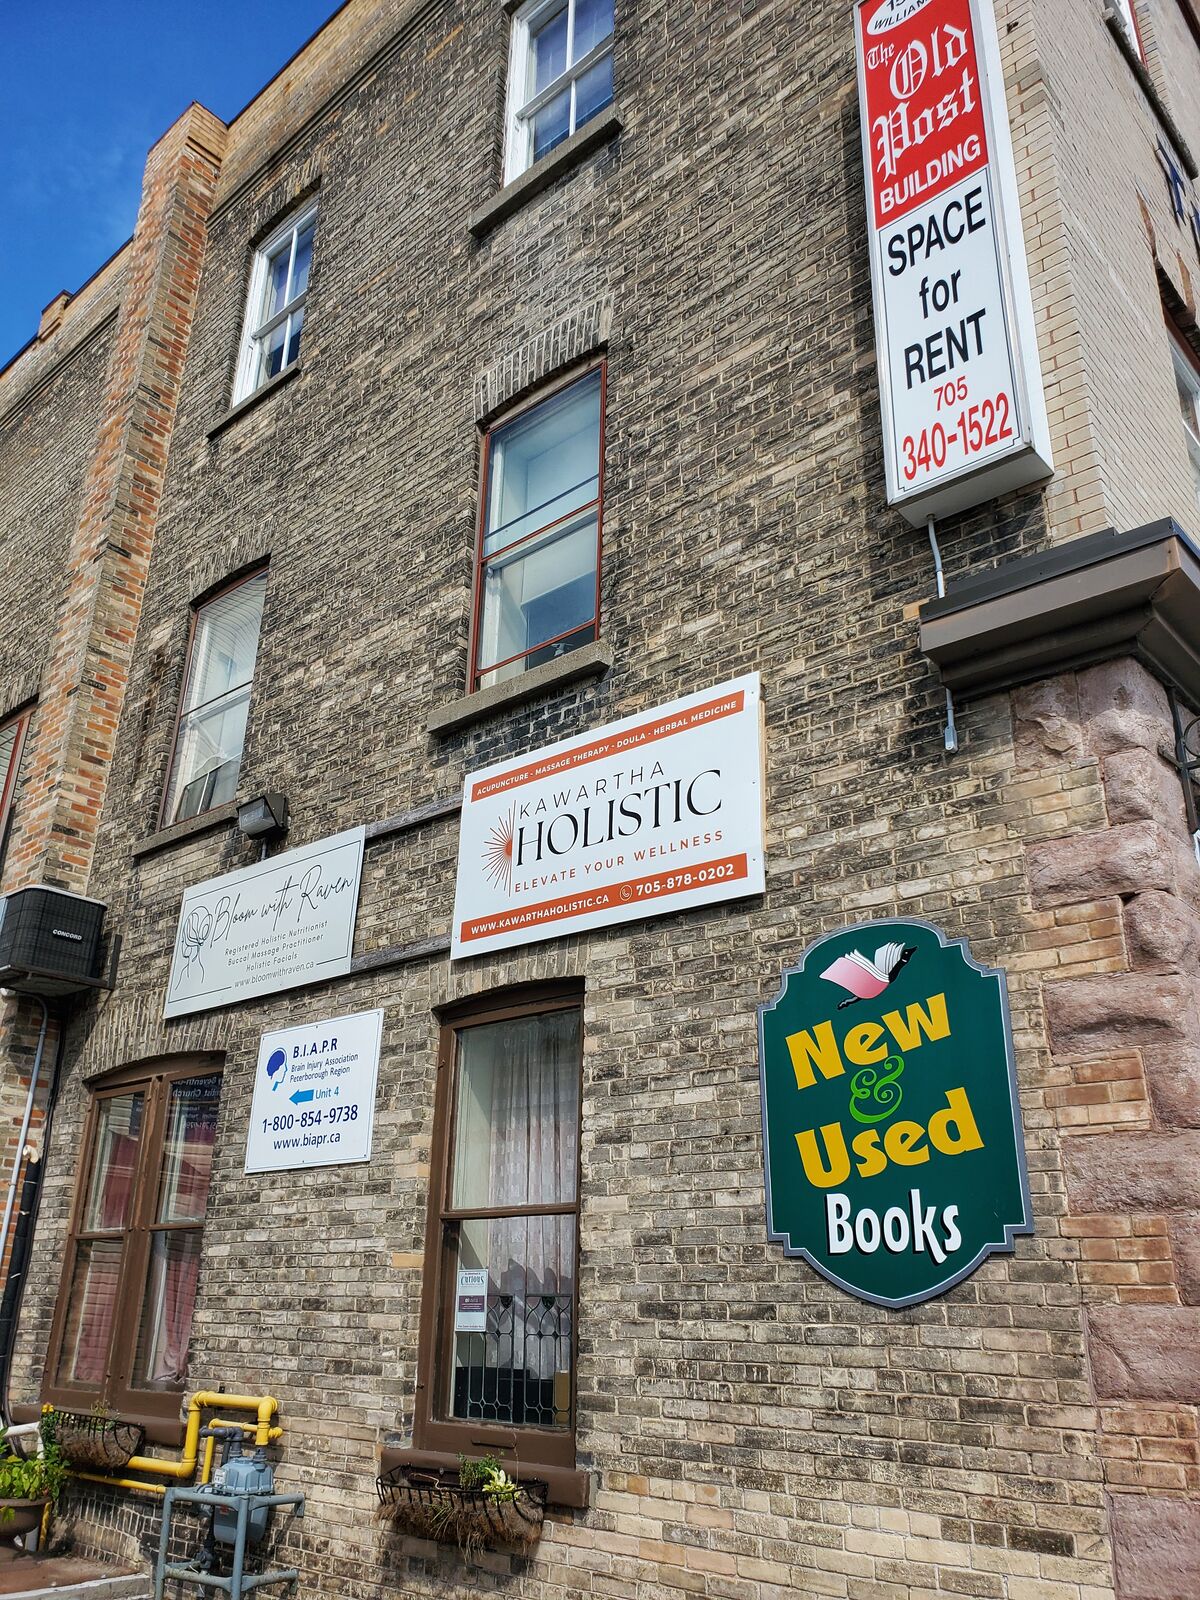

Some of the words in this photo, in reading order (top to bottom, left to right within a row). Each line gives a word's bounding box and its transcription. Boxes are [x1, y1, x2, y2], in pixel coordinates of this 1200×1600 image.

[866, 41, 895, 70] The
[889, 23, 968, 100] Old
[872, 67, 976, 182] Post
[880, 134, 982, 215] BUILDING
[888, 186, 986, 276] SPACE
[919, 269, 961, 319] for
[904, 308, 986, 390] RENT
[933, 376, 968, 411] 705
[902, 392, 1012, 480] 340-1522
[477, 772, 528, 795] ACUPUNCTURE
[535, 758, 570, 776] MASSAGE
[573, 745, 609, 762] THERAPY
[617, 732, 646, 748] DOULA
[653, 719, 688, 735] HERBAL
[690, 701, 737, 722] MEDICINE
[515, 769, 722, 867] HOLISTIC
[519, 761, 665, 820] KAWARTHA
[514, 868, 576, 893] ELEVATE
[584, 855, 625, 874] YOUR
[633, 830, 723, 861] WELLNESS
[210, 893, 259, 948] Bloom
[260, 875, 299, 931] with
[297, 864, 353, 923] Raven
[471, 894, 609, 935] WWW.KAWARTHAHOLISTIC.CA
[636, 863, 735, 896] 705-878-0202
[52, 929, 82, 941] CONCORD
[225, 940, 259, 956] Registered
[261, 932, 286, 946] Holistic
[288, 920, 328, 938] Nutritionist
[228, 953, 250, 966] Buccal
[251, 947, 280, 960] Massage
[282, 934, 324, 951] Practitioner
[246, 960, 271, 972] Holistic
[273, 951, 298, 965] Facials
[234, 961, 314, 988] www.bloomwithraven.ca
[291, 1062, 305, 1073] Brain
[307, 1060, 323, 1072] Injury
[325, 1053, 359, 1066] Association
[292, 1038, 338, 1059] B.I.A.P.R
[785, 992, 951, 1090] New
[289, 1069, 329, 1083] Peterborough
[330, 1065, 351, 1078] Region
[315, 1088, 332, 1100] Unit
[334, 1086, 339, 1097] 4
[848, 1054, 905, 1124] &
[262, 1104, 359, 1133] 1-800-854-9738
[273, 1132, 341, 1150] www.biapr.ca
[794, 1087, 985, 1189] Used
[825, 1188, 962, 1265] Books
